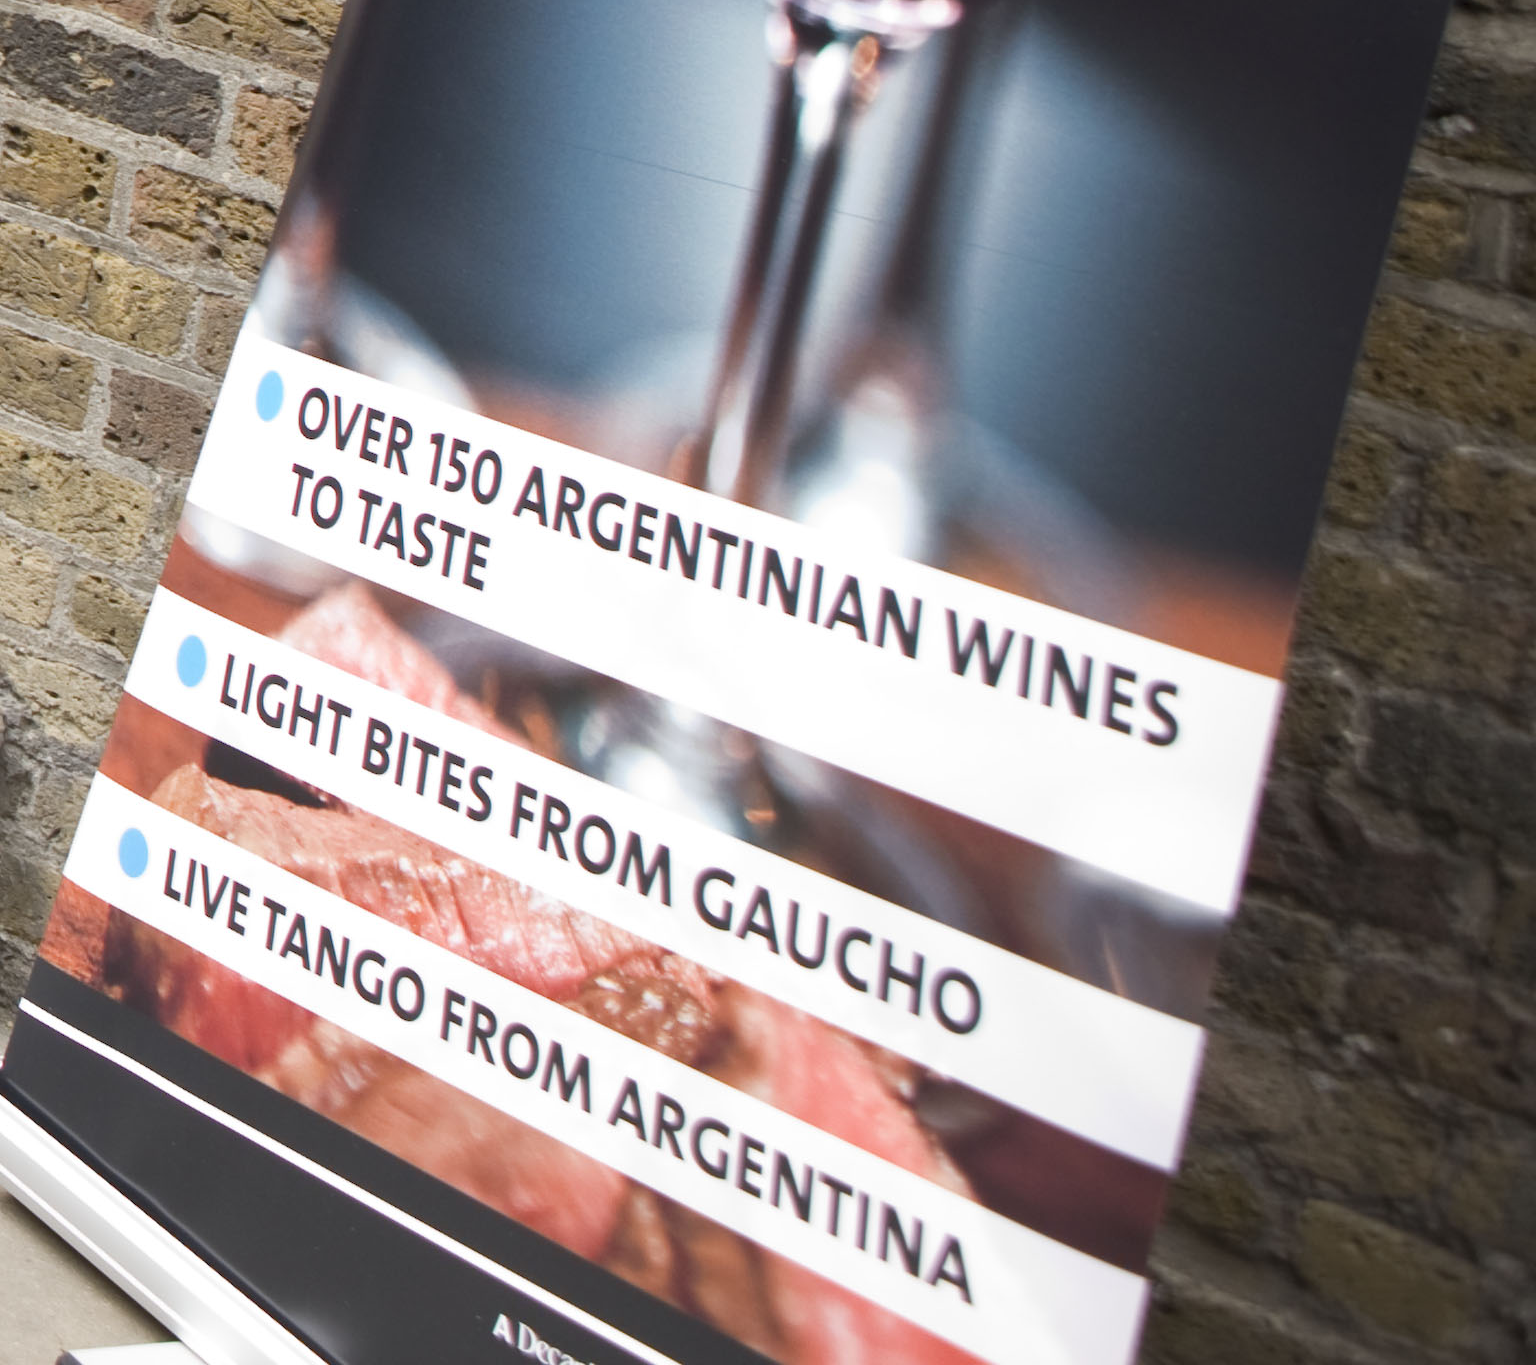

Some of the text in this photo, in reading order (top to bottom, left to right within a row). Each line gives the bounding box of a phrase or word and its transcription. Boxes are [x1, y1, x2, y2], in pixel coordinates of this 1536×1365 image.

[290, 463, 493, 593] TO TASTE
[296, 384, 1181, 749] OVER 150 ARGENTINIAN WINES
[218, 651, 985, 1041] LIGHT BITES FROM GAUCHO
[161, 843, 978, 1307] LIVE TANGO FROM ARGENTINA
[492, 1313, 515, 1346] A
